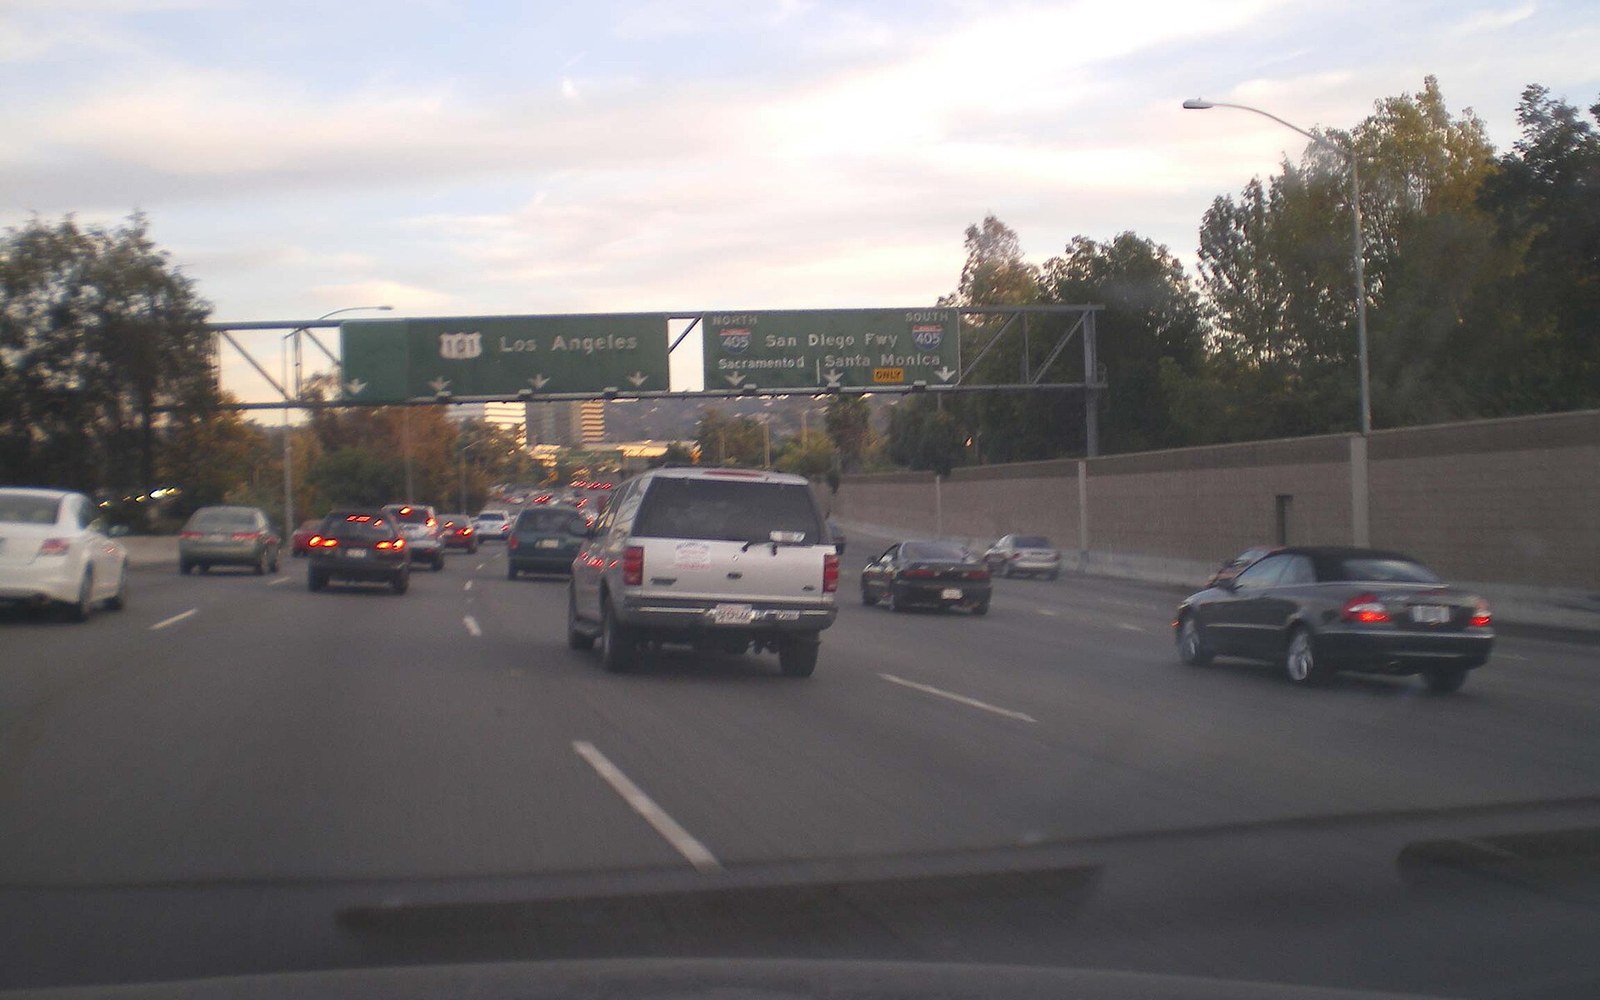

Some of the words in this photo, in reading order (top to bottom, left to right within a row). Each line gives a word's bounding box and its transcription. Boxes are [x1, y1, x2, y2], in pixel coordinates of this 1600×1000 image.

[711, 315, 758, 325] NORTH
[905, 311, 949, 322] SOUTH
[722, 336, 749, 348] 405
[765, 335, 797, 348] San
[807, 334, 855, 349] Diego
[864, 333, 898, 348] Fwy
[916, 332, 941, 344] 405
[499, 336, 536, 352] Los
[552, 334, 638, 355] Angeles
[825, 355, 871, 368] Santa
[880, 353, 941, 367] Monica
[875, 370, 902, 379] ONLY
